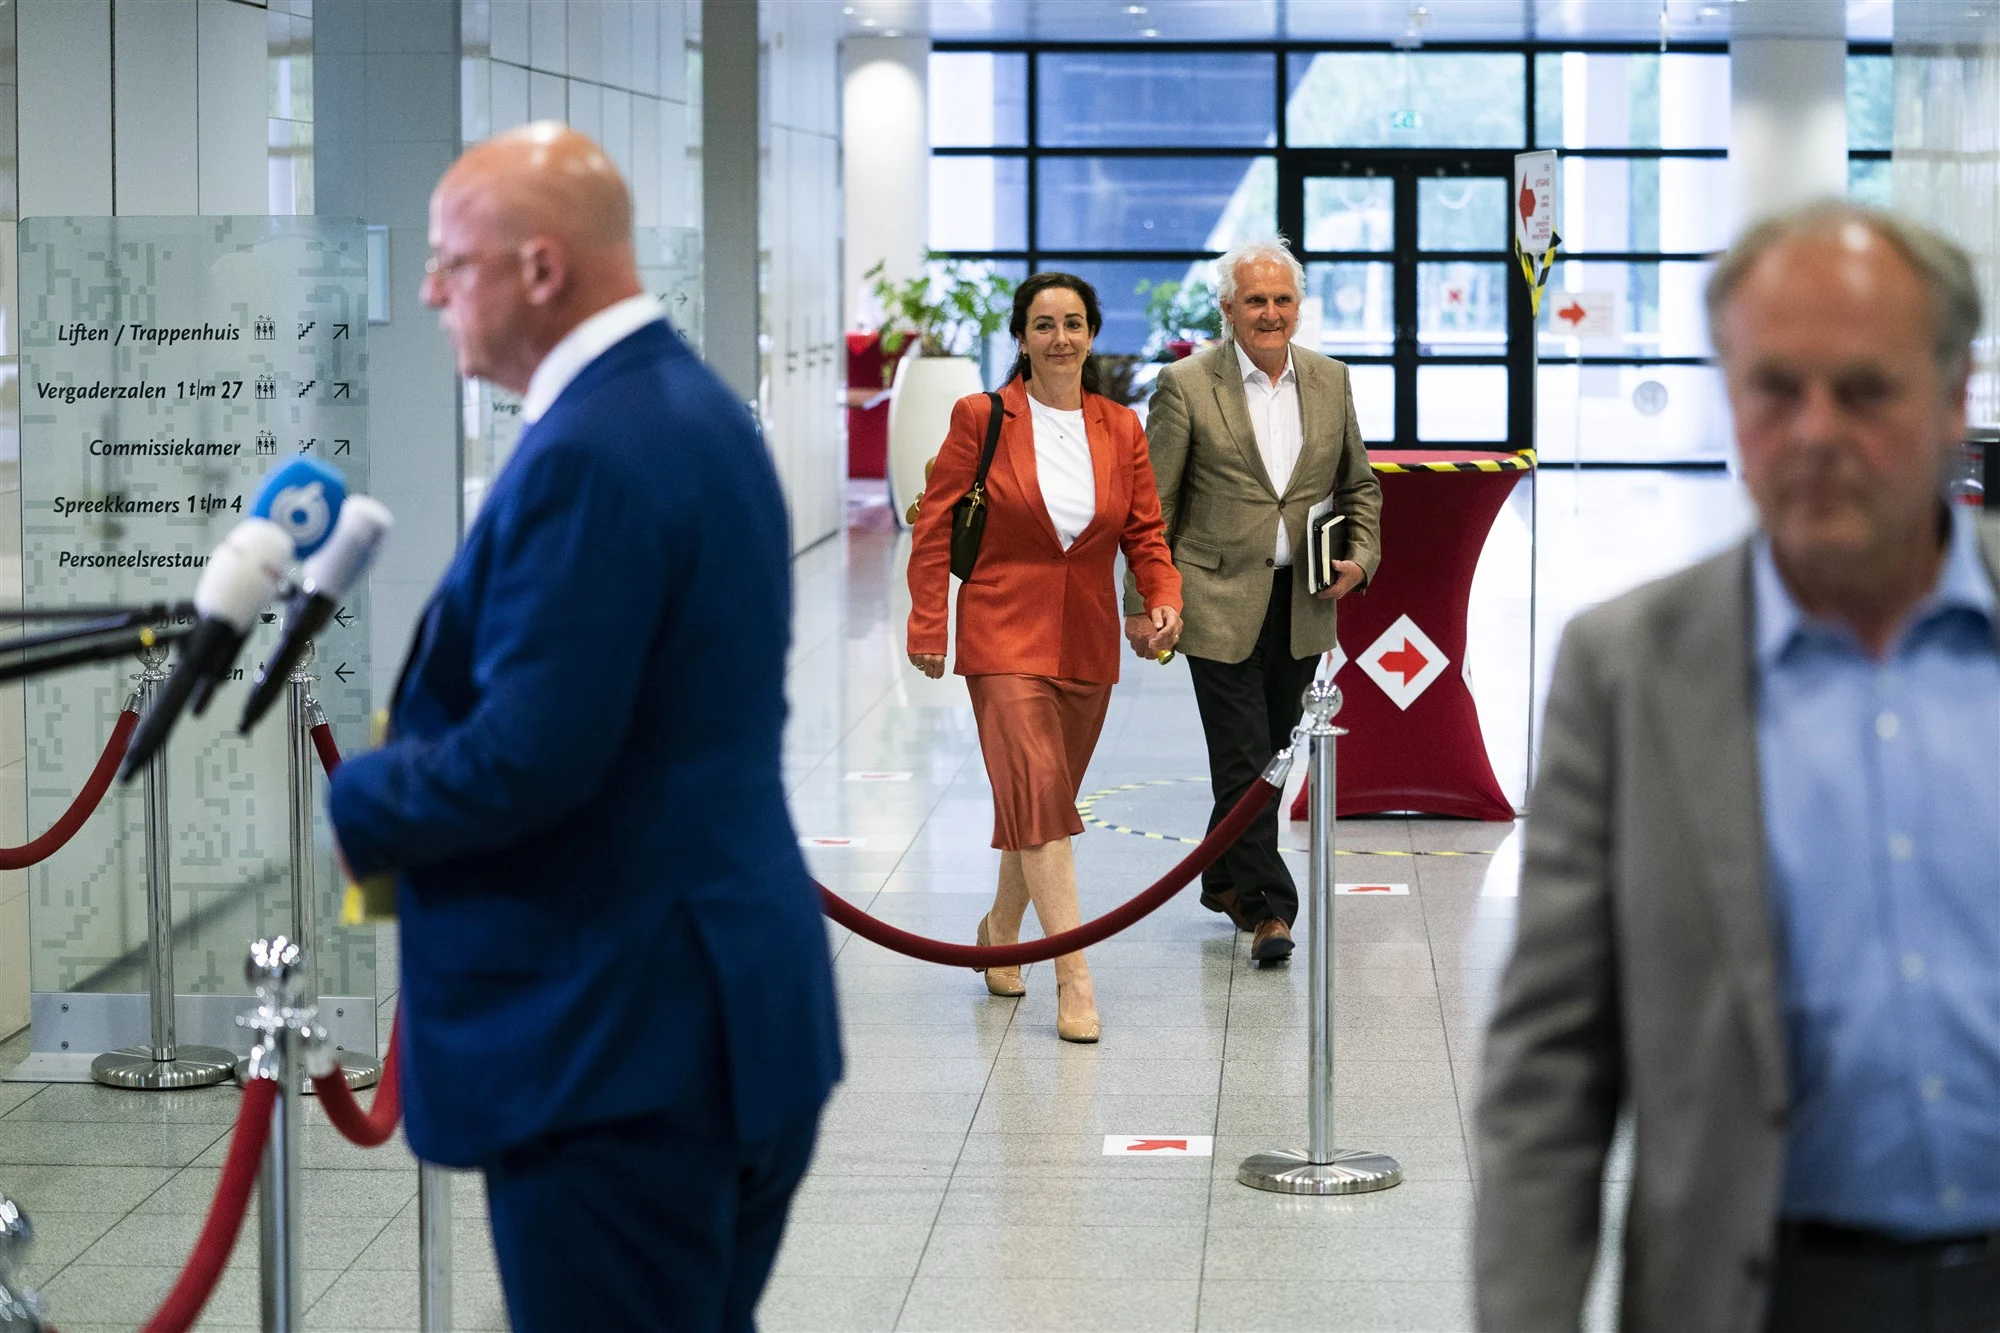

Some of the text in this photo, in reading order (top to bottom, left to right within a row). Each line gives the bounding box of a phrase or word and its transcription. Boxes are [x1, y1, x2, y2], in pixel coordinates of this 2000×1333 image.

[58, 322, 241, 347] Liften / Trappenhuis
[37, 380, 167, 404] Vergaderzalen
[177, 381, 184, 400] 1
[221, 380, 244, 400] 27
[89, 437, 241, 456] Commissiekamer
[53, 492, 181, 514] Spreekkamers
[187, 495, 196, 514] 1
[230, 495, 242, 514] 4
